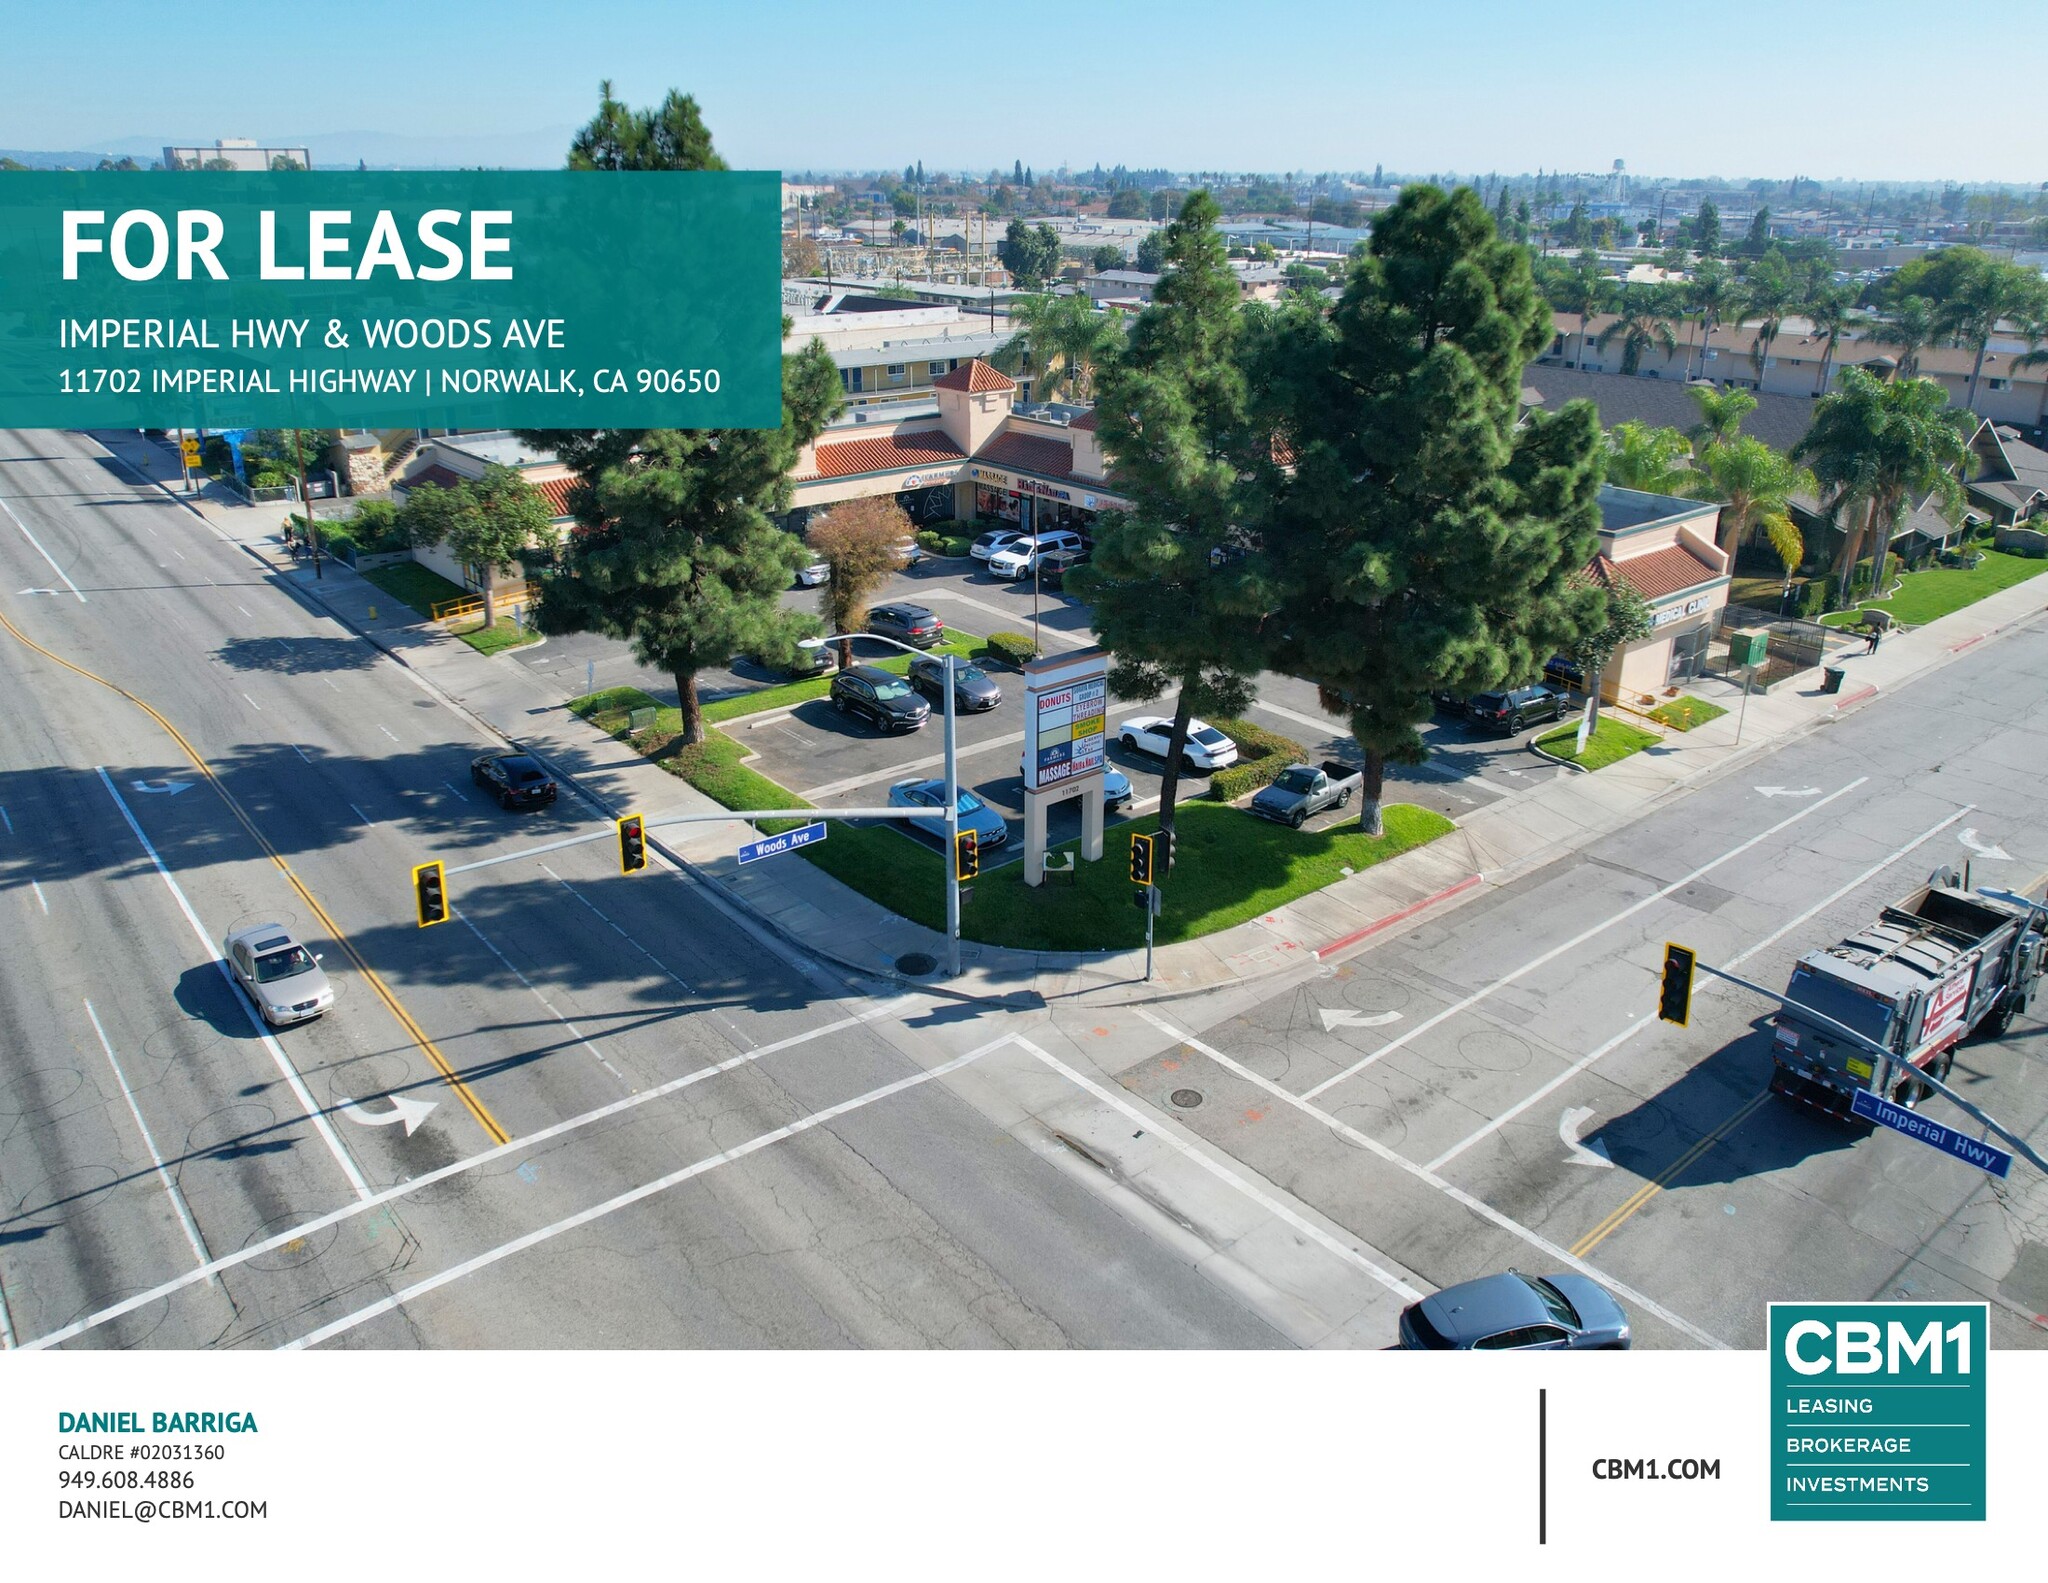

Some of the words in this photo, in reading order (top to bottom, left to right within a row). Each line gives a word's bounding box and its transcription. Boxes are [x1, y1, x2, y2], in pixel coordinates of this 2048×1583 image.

[208, 415, 255, 427] MOTEL
[1040, 692, 1071, 709] DONUTS
[1076, 699, 1103, 712] EYEBROW
[1073, 707, 1105, 721] THREADING
[1075, 717, 1101, 730] SMOKE
[1078, 725, 1097, 736] SHOP
[1039, 762, 1071, 784] MASSAGE
[1061, 786, 1080, 796] 11702
[756, 838, 787, 856] Woods
[791, 832, 810, 845] Ave
[1875, 1102, 1946, 1146] Imperial
[1954, 1136, 1997, 1169] Hwy
